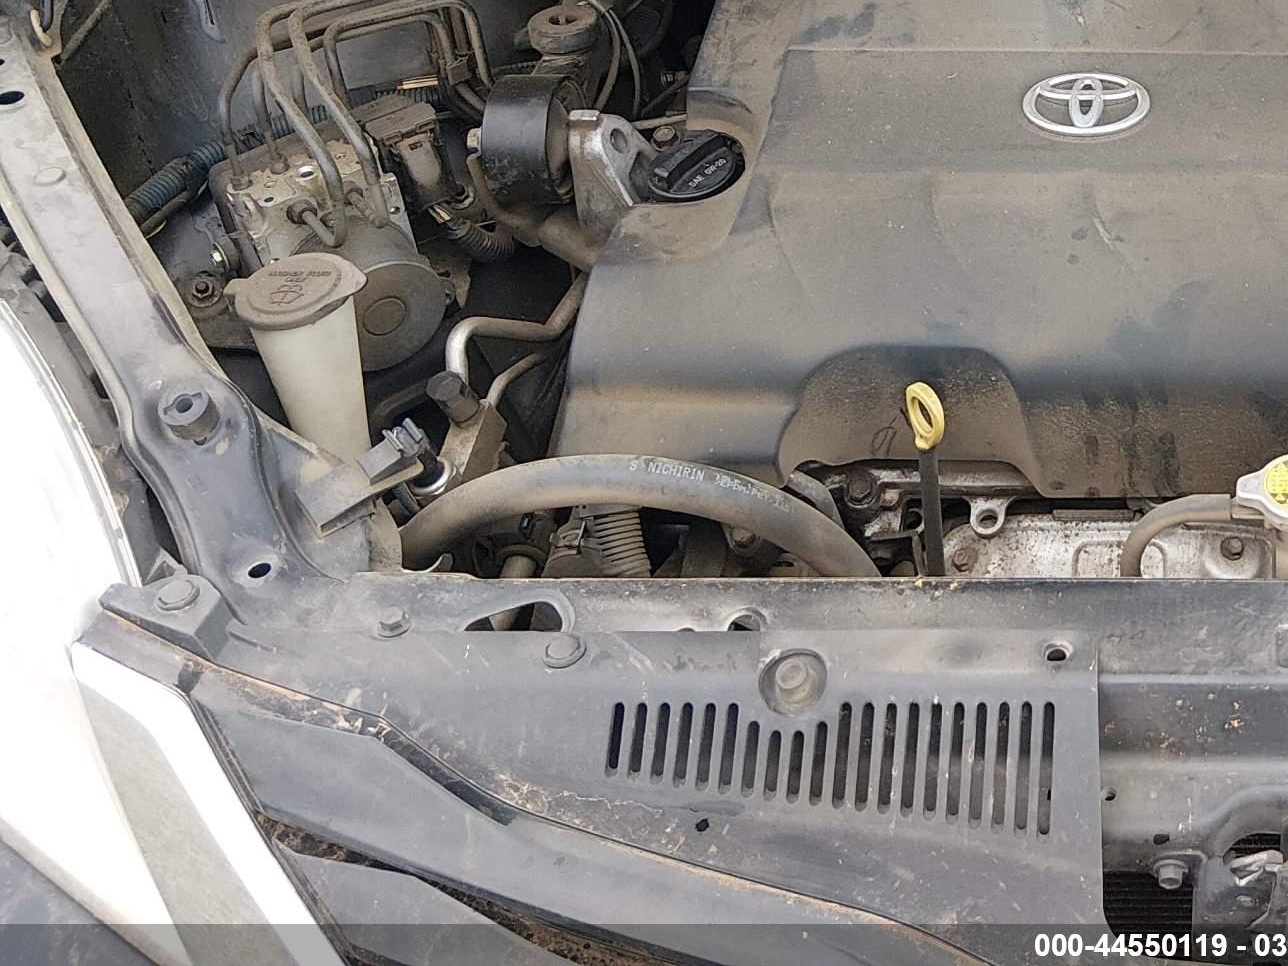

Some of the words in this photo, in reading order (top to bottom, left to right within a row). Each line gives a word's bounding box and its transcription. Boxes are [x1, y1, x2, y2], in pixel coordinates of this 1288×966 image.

[687, 174, 705, 188] SAE
[704, 158, 727, 175] 0W-20
[647, 461, 705, 482] NICHIRIN
